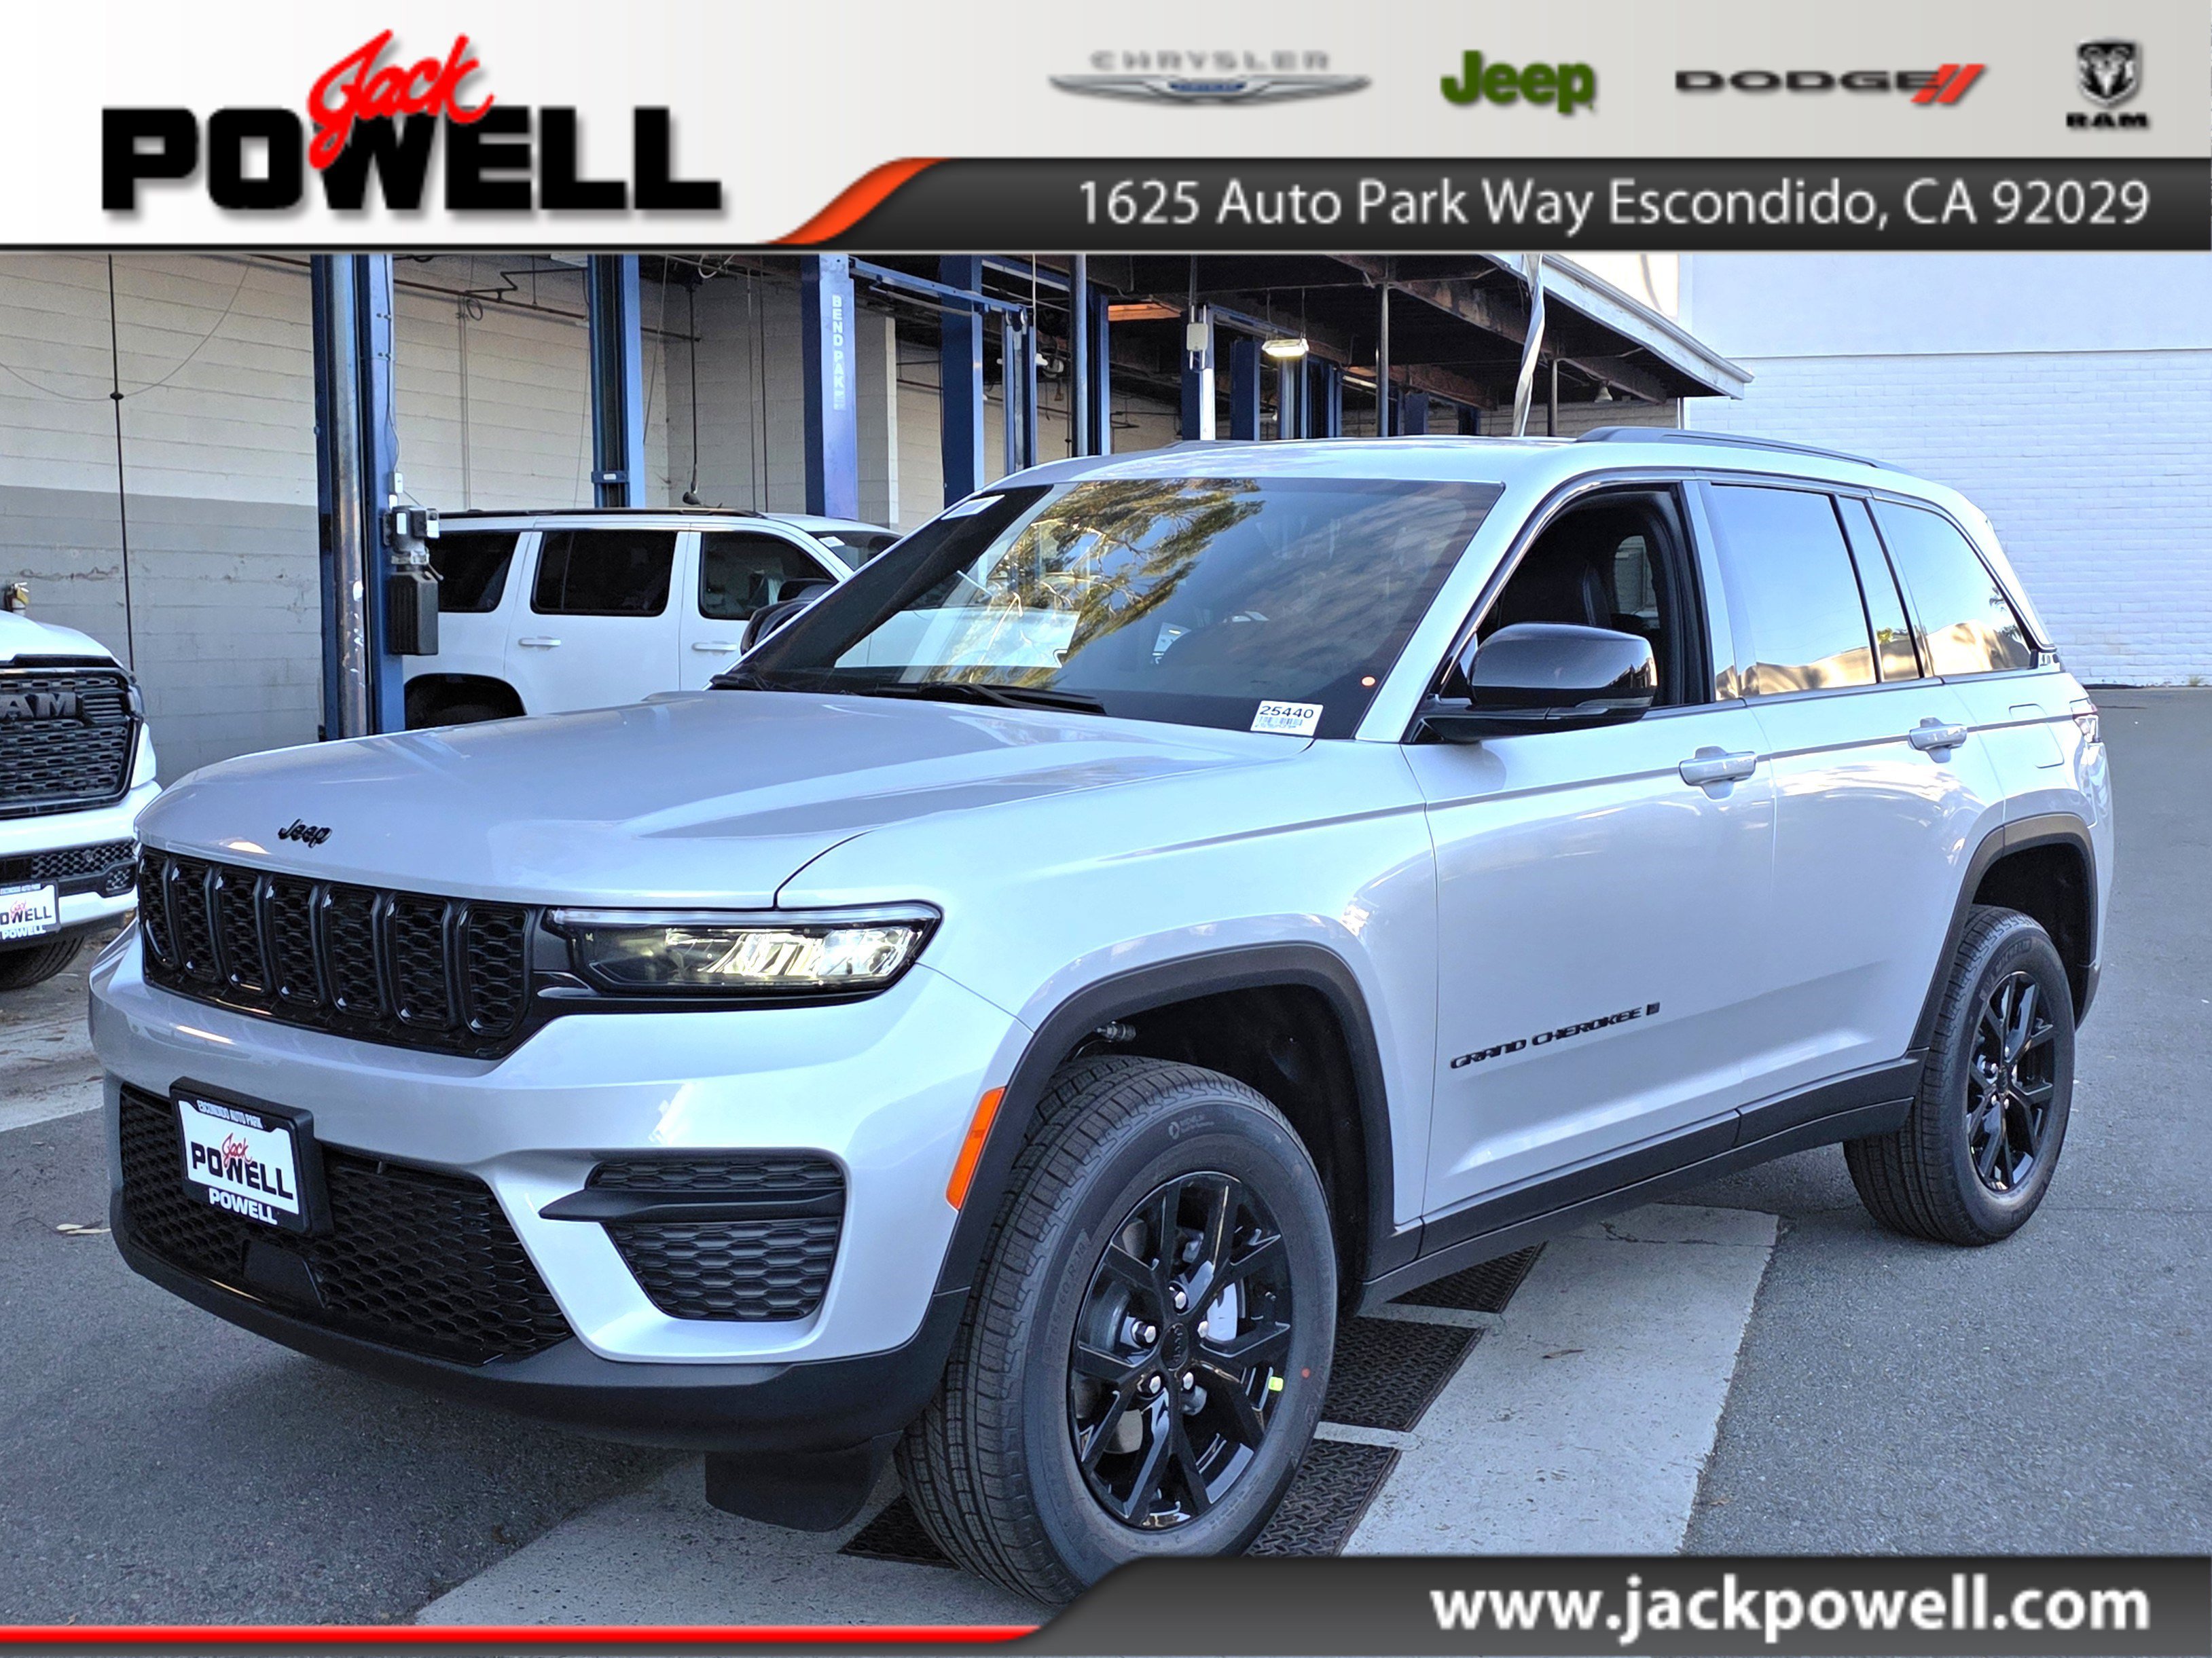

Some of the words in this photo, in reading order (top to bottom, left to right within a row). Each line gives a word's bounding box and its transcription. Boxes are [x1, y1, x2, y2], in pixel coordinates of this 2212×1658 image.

[0, 692, 77, 719] AM
[1259, 705, 1315, 719] 25440
[277, 818, 332, 849] Jeep
[0, 906, 52, 925] OWELL
[1450, 1039, 1527, 1069] GRAND
[1531, 1007, 1642, 1046] CHEROKEE
[222, 1132, 253, 1168] Jack
[190, 1141, 294, 1200] POWELL
[208, 1187, 278, 1226] POWELL
